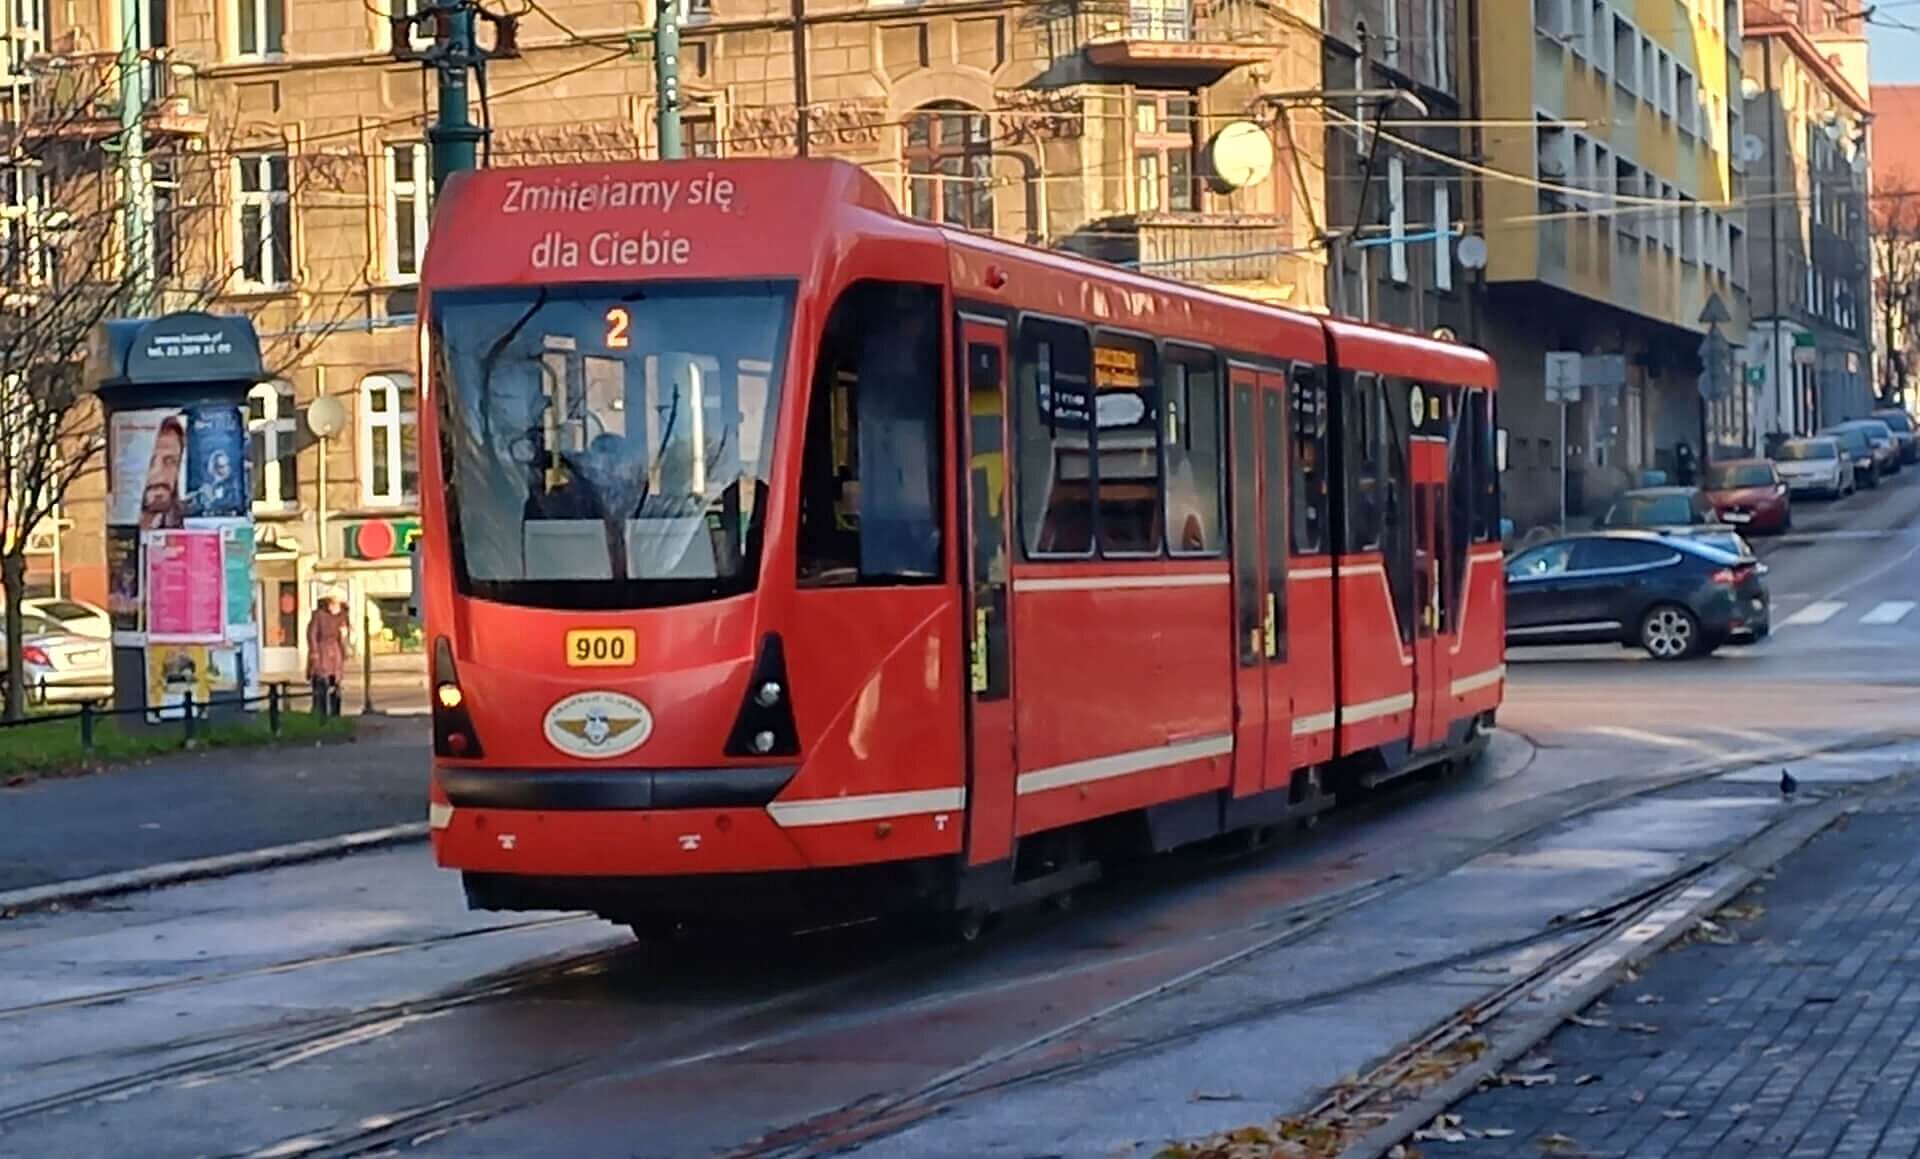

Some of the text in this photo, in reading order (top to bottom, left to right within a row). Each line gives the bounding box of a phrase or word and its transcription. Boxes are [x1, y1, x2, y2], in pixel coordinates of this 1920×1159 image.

[687, 171, 734, 213] się
[531, 229, 691, 268] dla Ciebie
[606, 308, 629, 347] 2
[575, 637, 625, 660] 900
